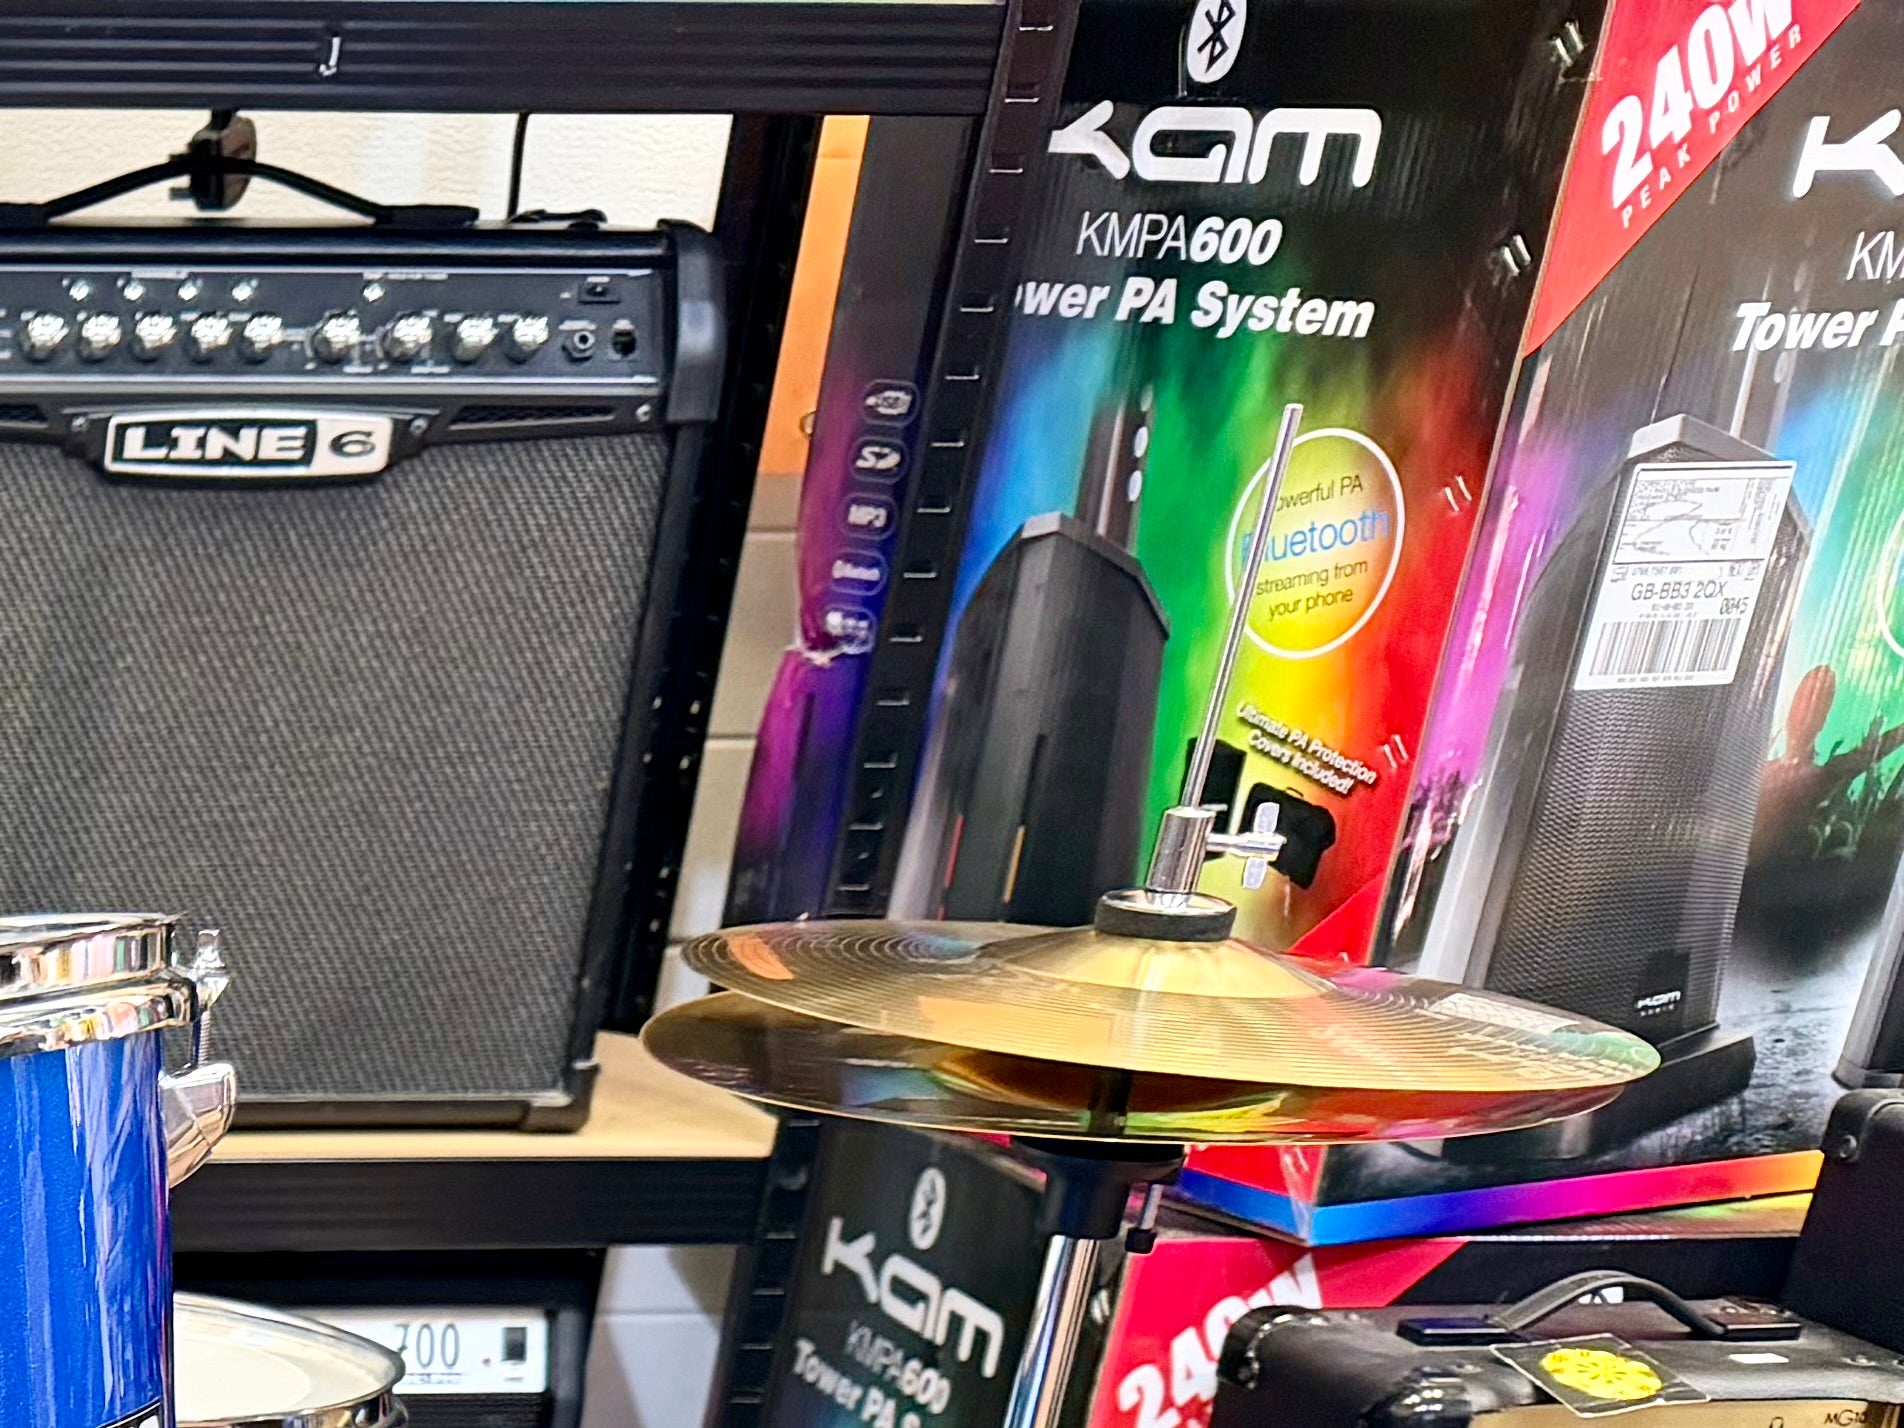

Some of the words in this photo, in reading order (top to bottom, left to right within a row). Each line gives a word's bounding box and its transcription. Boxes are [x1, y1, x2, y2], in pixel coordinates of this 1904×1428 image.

[1601, 0, 1792, 209] 240W
[1621, 147, 1690, 228] PEAK
[1708, 24, 1801, 134] POWER
[1075, 210, 1283, 266] KMPA600
[1015, 281, 1110, 319] wer
[1115, 276, 1178, 324] PA
[1191, 280, 1375, 338] System
[1733, 302, 1879, 352] Tower
[122, 425, 310, 461] LINE
[328, 430, 376, 458] 6
[1275, 480, 1335, 512] owerful
[1340, 474, 1364, 496] PA
[1255, 569, 1330, 597] streaming
[1334, 559, 1368, 582] from
[1630, 581, 1693, 601] GB-BB3
[1692, 579, 1729, 599] 2QX
[1268, 599, 1302, 622] your
[1305, 586, 1354, 616] phone
[1247, 728, 1292, 765] Covers
[1307, 737, 1378, 787] Protection
[794, 1337, 864, 1411] Tower
